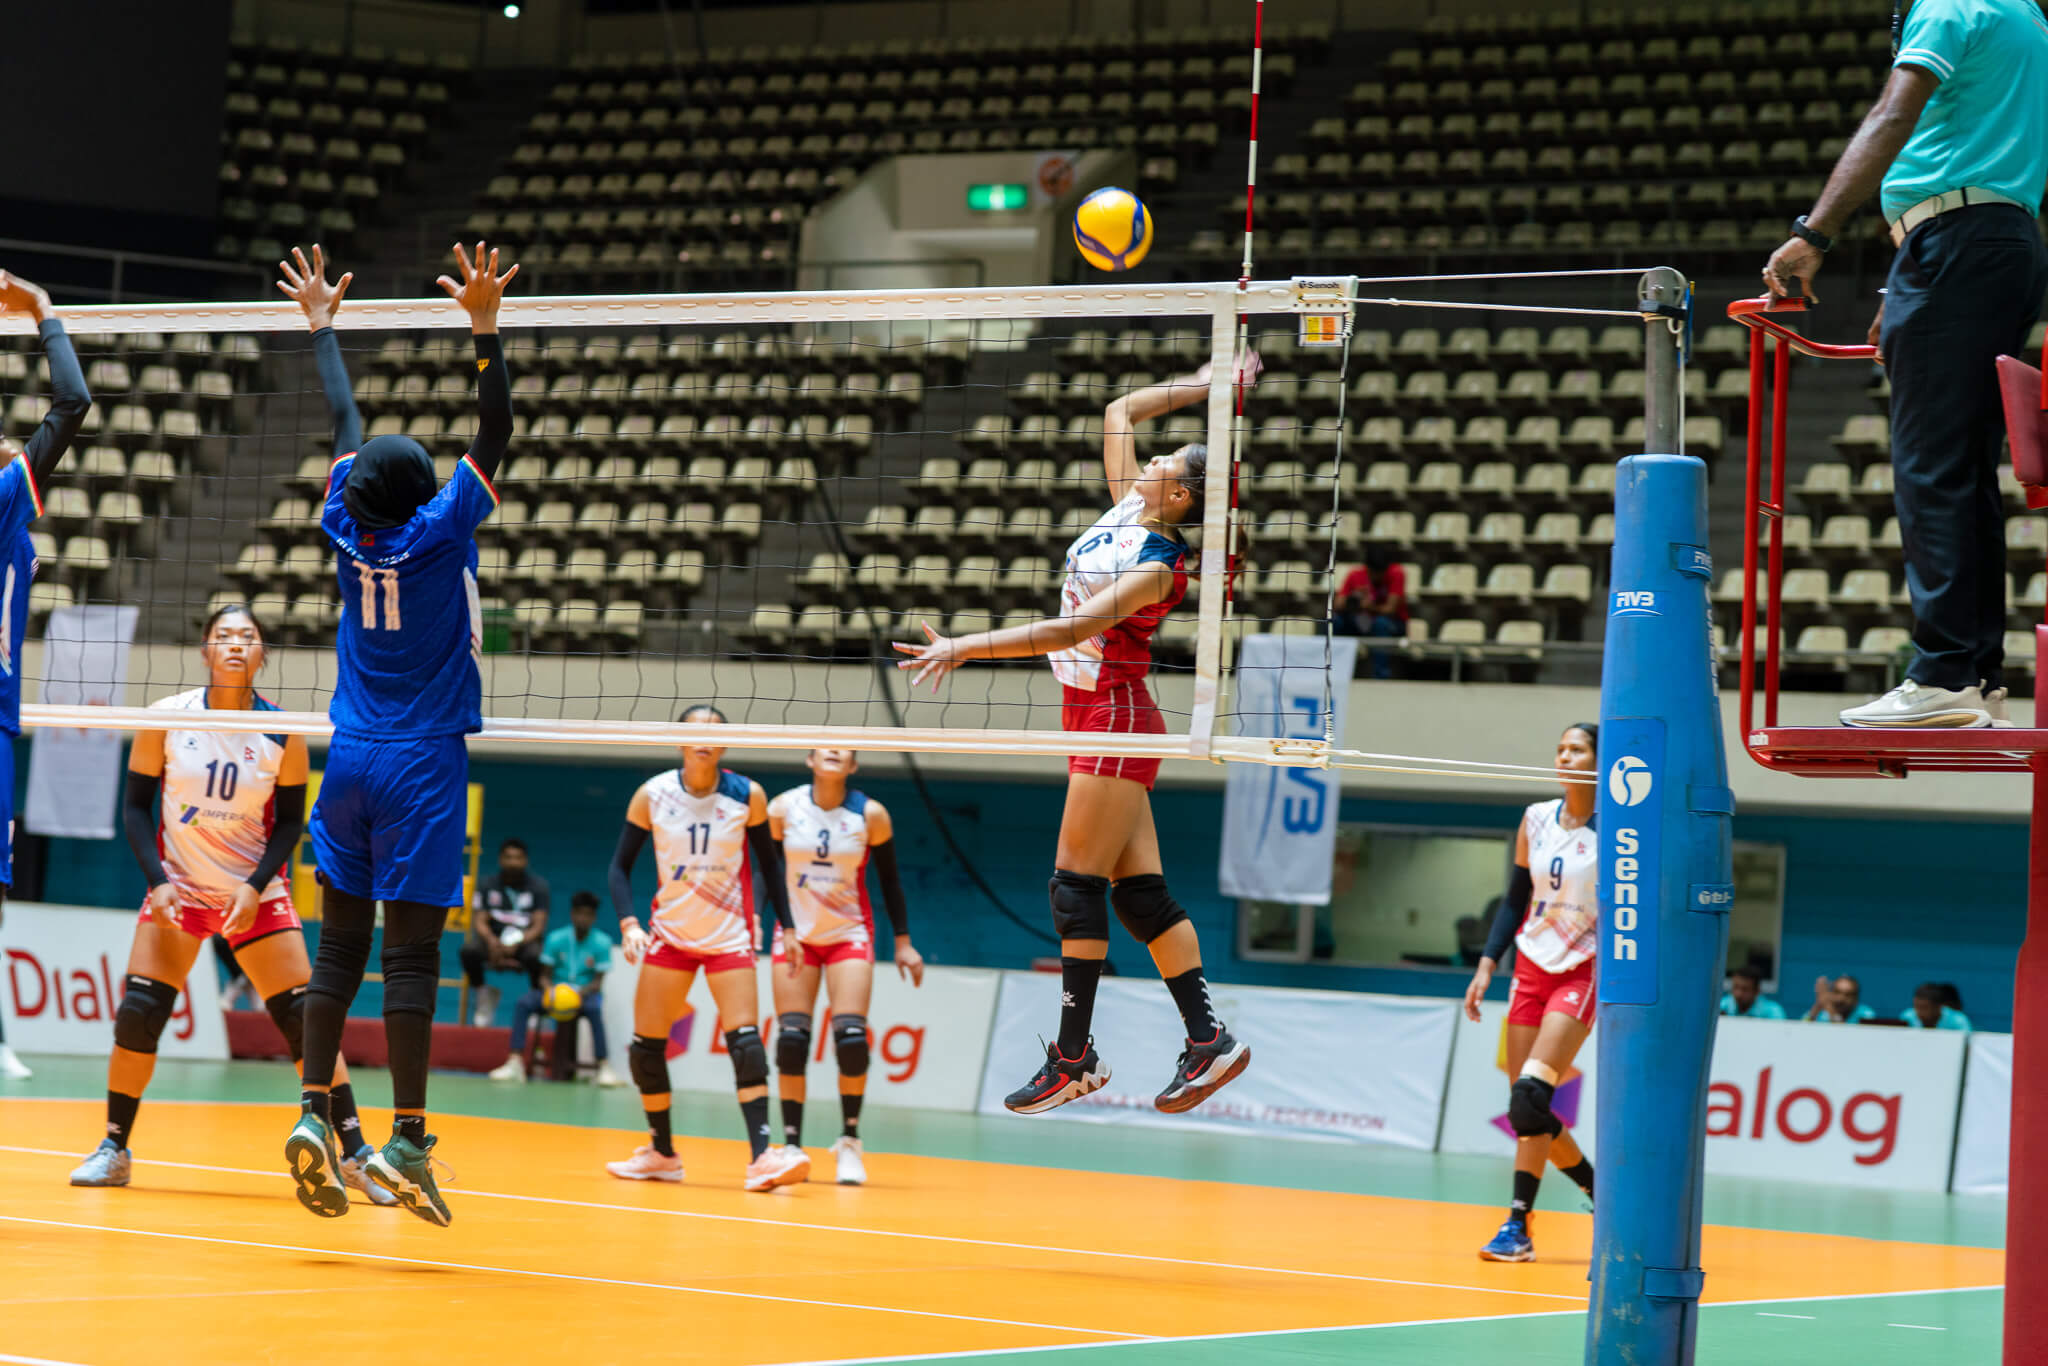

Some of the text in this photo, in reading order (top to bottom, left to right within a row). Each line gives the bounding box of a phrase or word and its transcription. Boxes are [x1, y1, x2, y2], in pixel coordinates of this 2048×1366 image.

[1077, 532, 1113, 556] 6
[352, 560, 401, 631] 11
[1616, 592, 1655, 608] FIVB
[206, 760, 238, 801] 10
[687, 823, 710, 855] 17
[817, 829, 831, 858] 3
[1550, 856, 1564, 890] 9
[5, 948, 195, 1040] Dialg
[1706, 1065, 1903, 1167] alog
